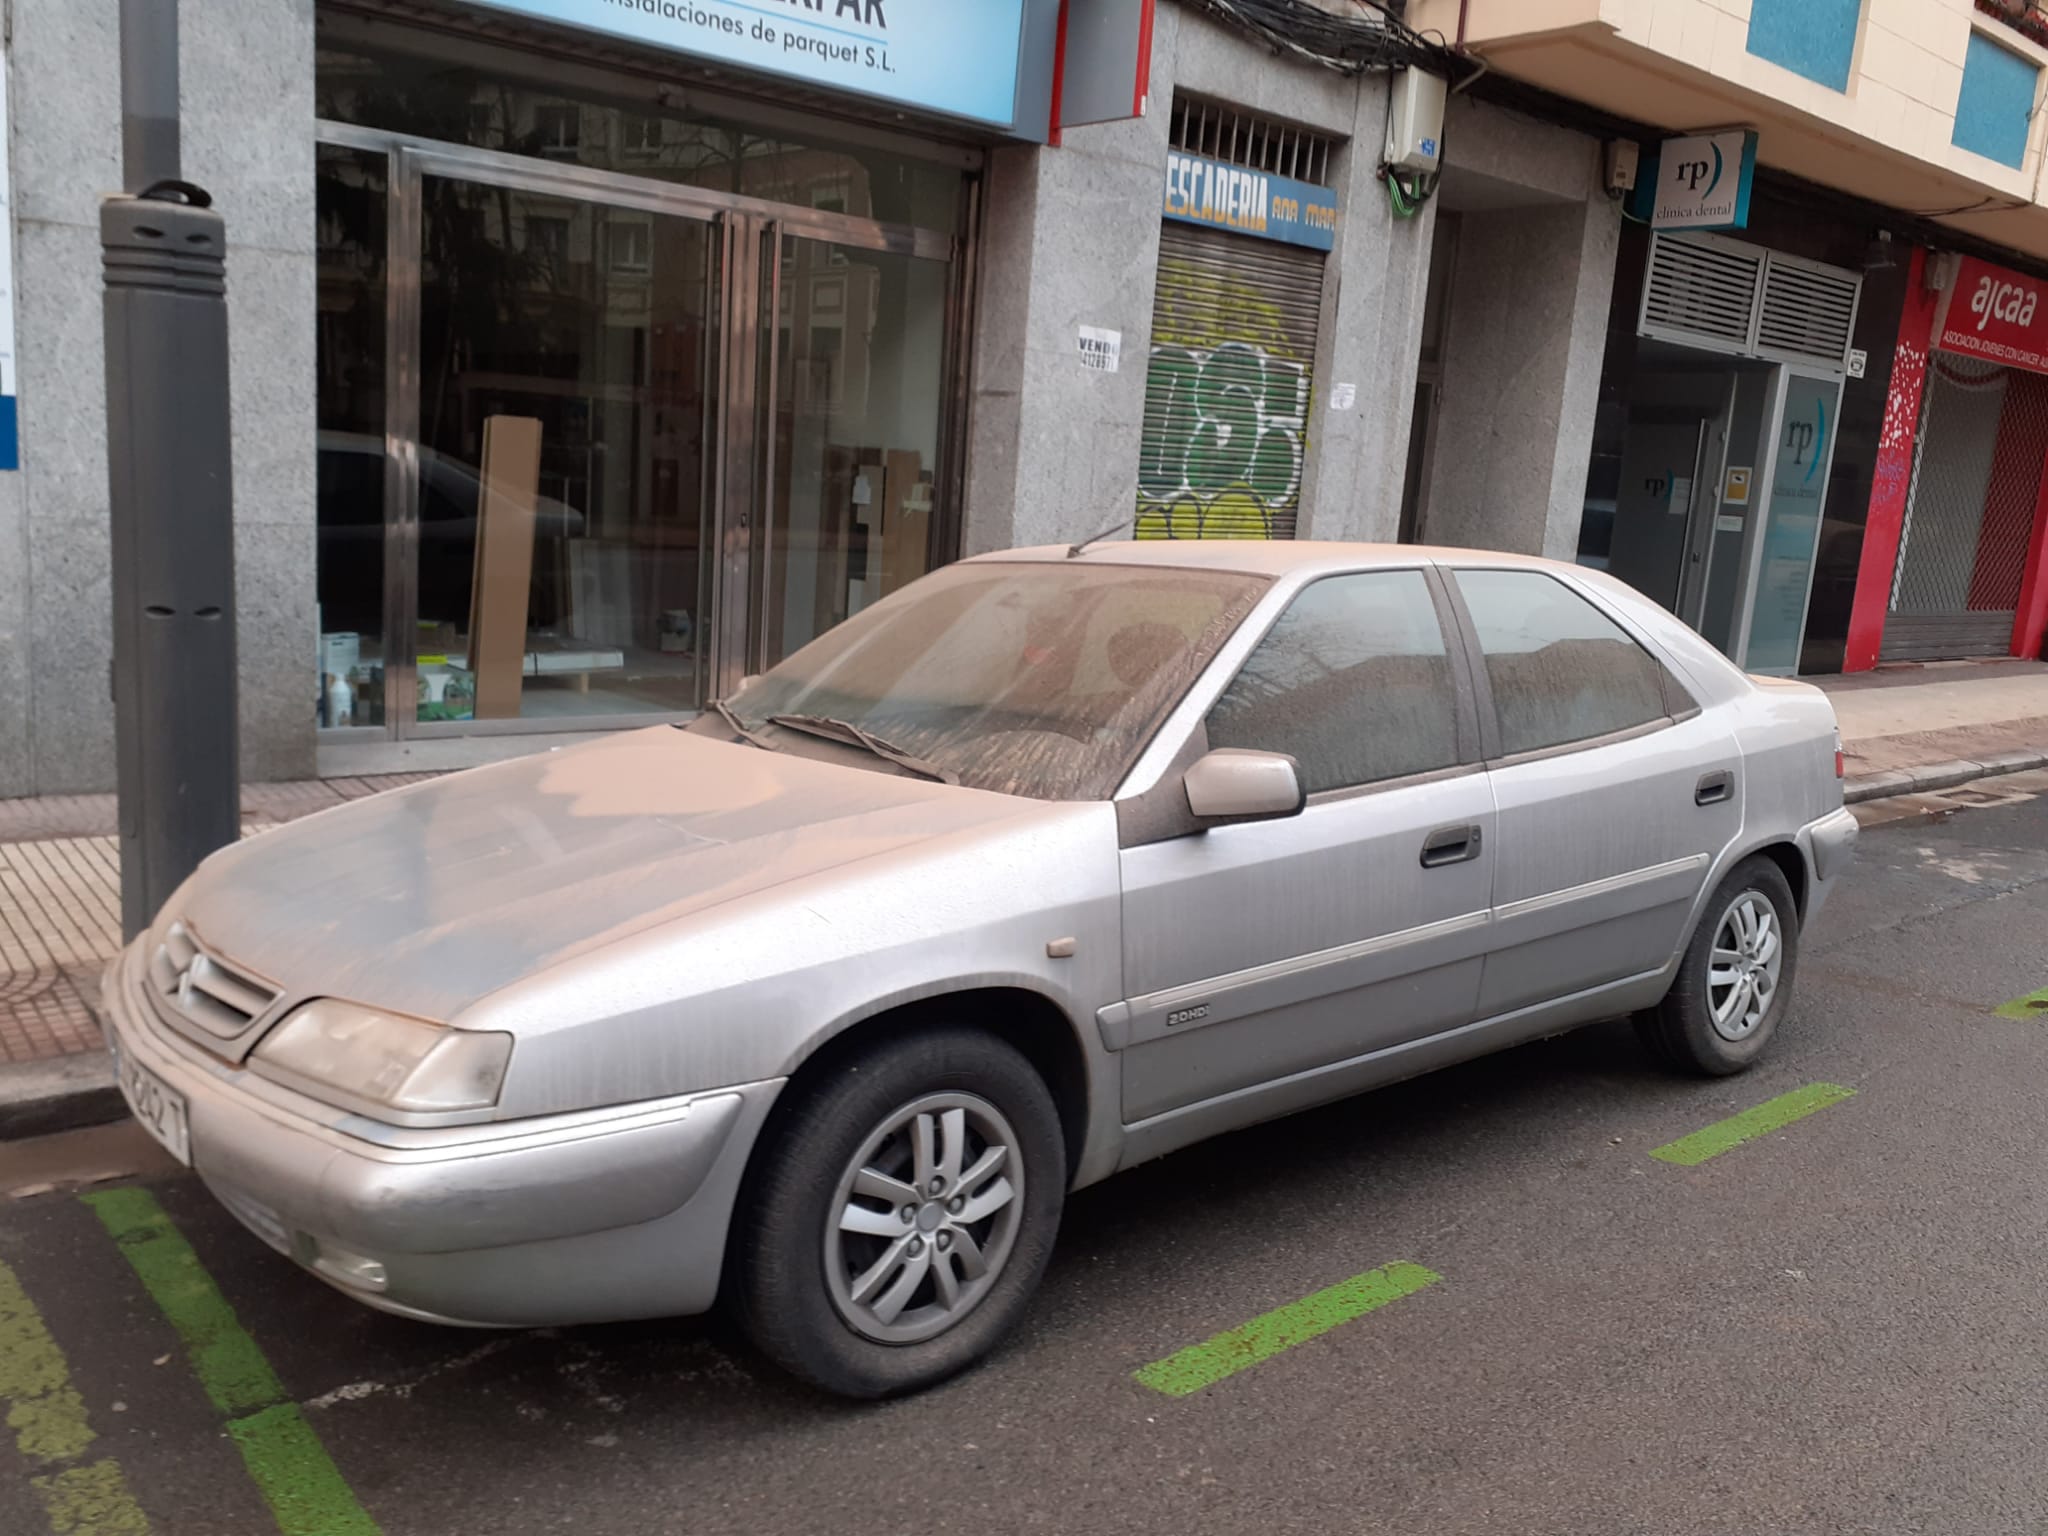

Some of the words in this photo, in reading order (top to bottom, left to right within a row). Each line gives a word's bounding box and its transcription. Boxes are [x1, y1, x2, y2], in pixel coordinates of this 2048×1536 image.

[751, 17, 776, 43] de
[783, 31, 858, 63] parquet
[864, 45, 896, 74] S.L.
[1695, 201, 1732, 217] dental
[1971, 275, 2038, 331] ajcaa
